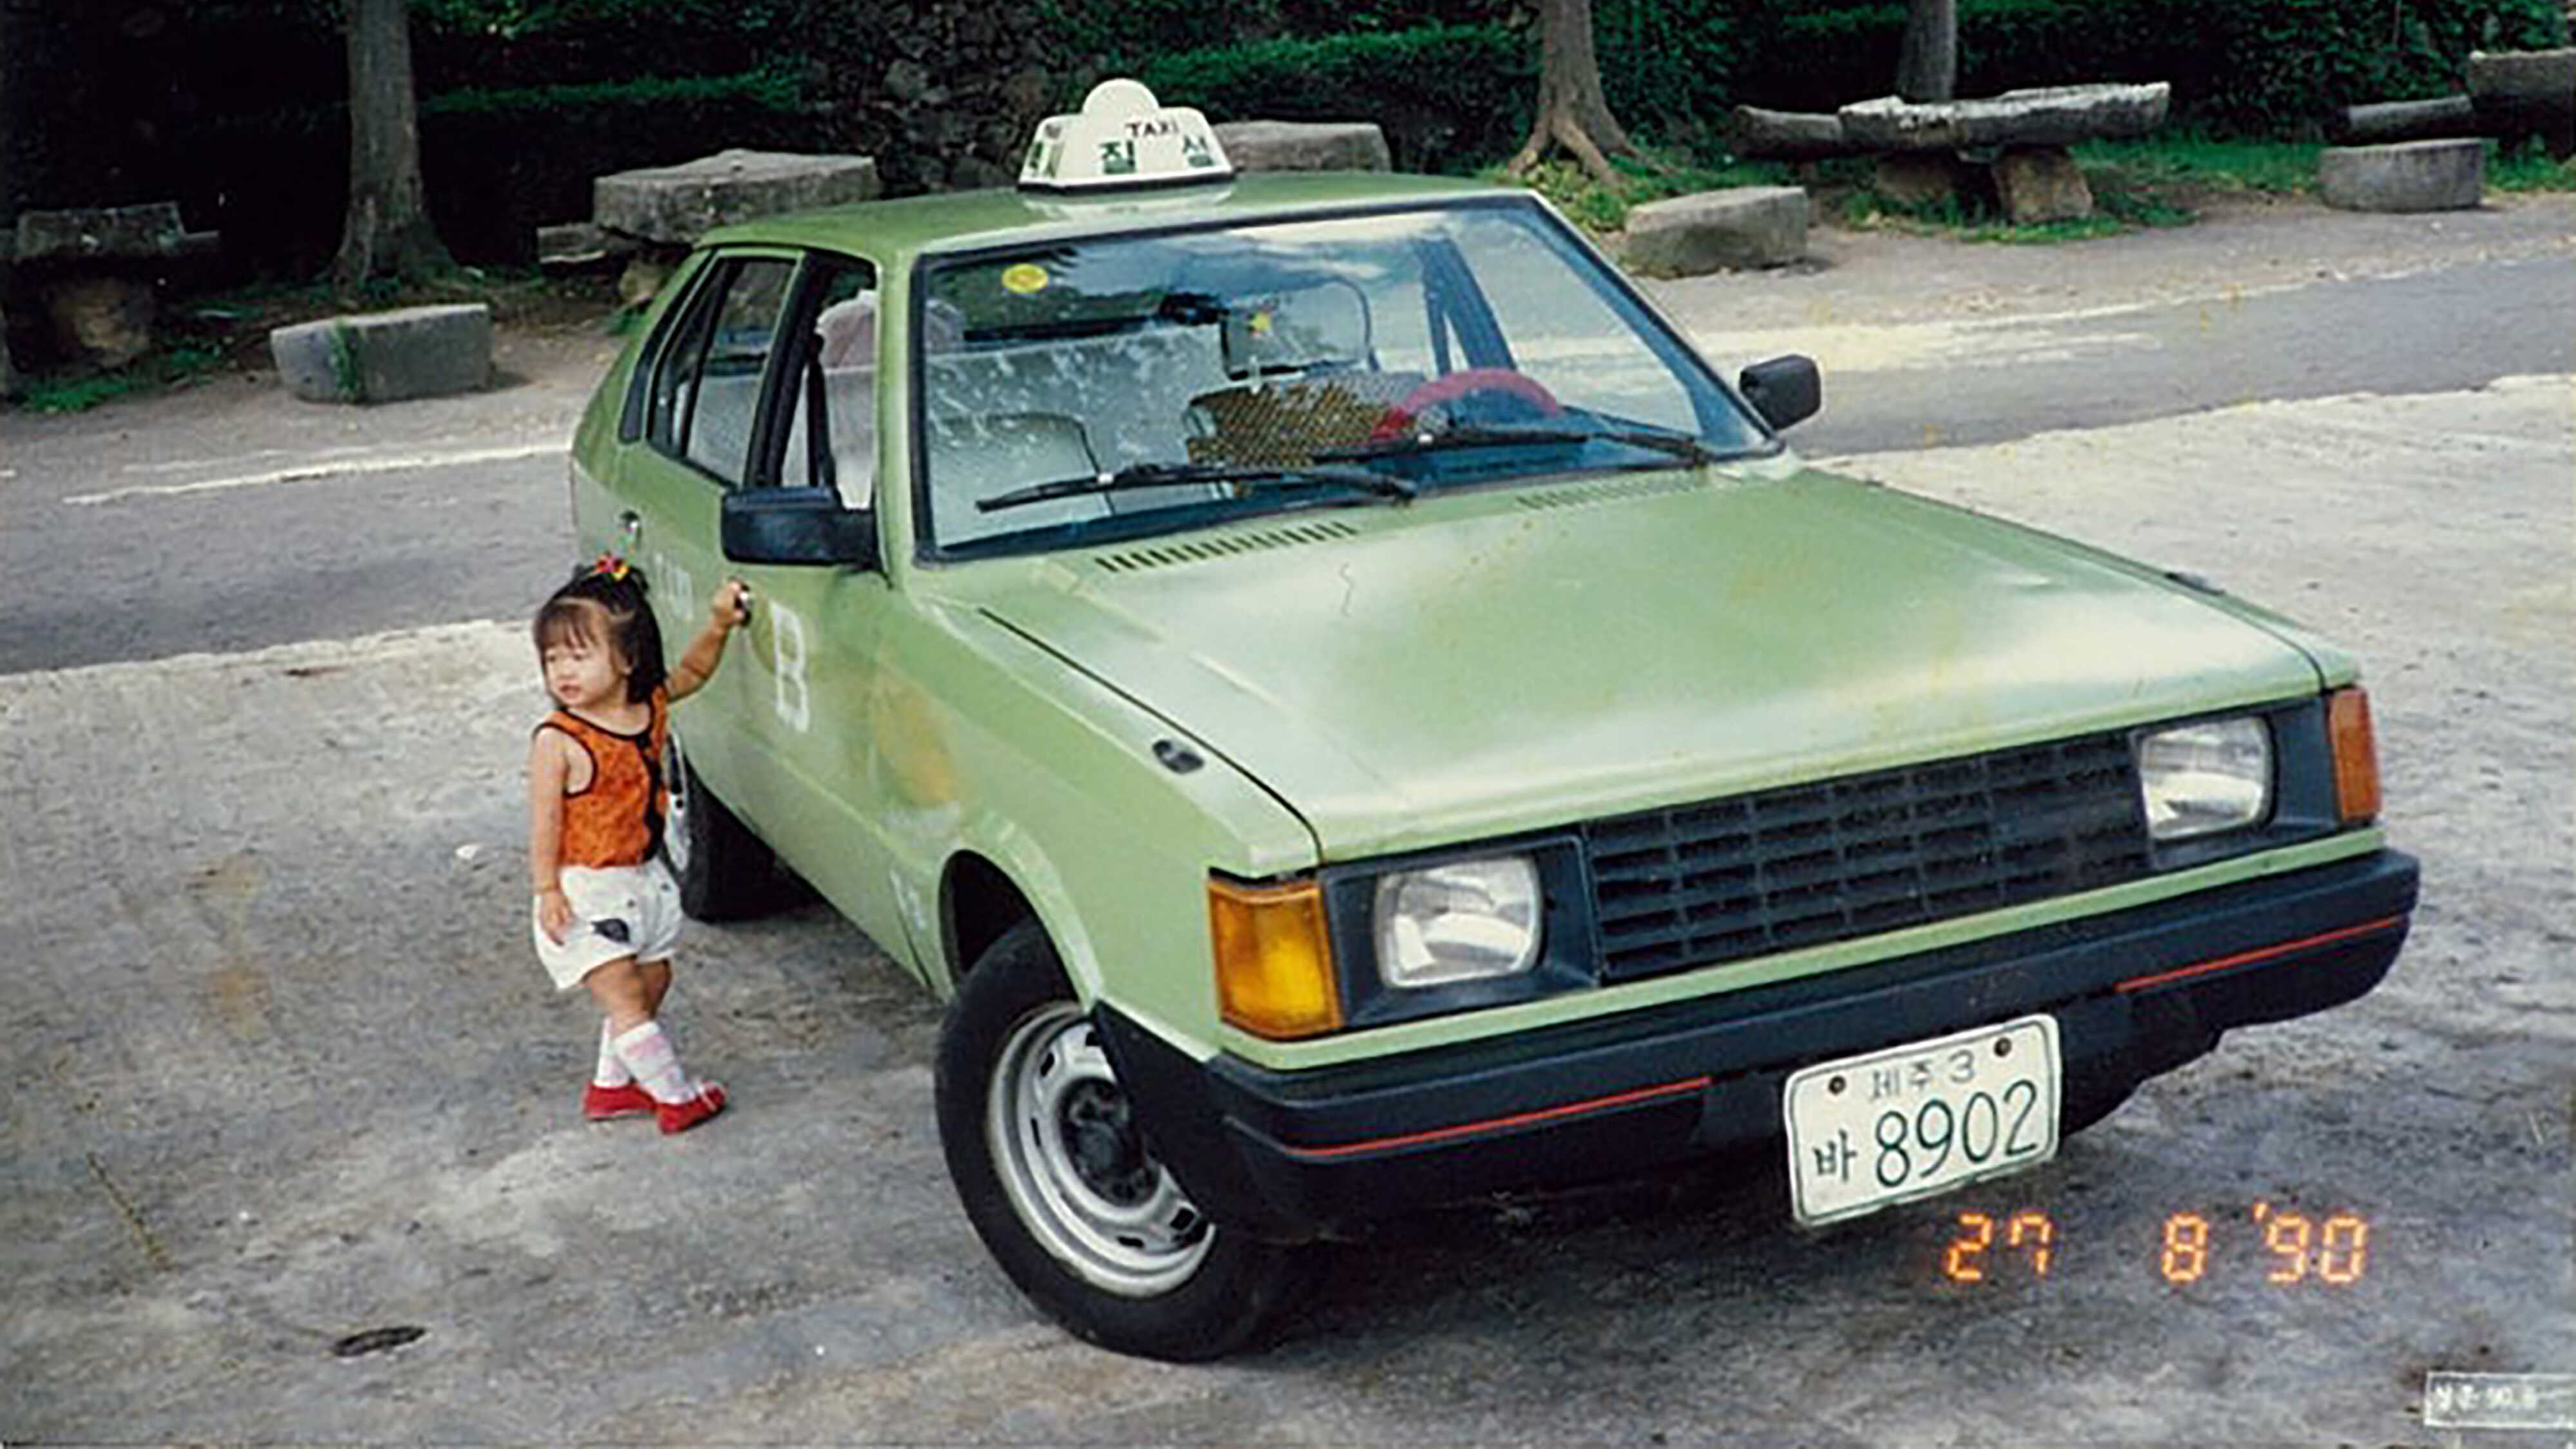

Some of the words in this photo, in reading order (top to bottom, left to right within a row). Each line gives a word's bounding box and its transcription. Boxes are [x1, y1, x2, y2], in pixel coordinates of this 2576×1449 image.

[1125, 118, 1179, 137] TAXI
[1868, 1058, 1934, 1103] 제주
[1948, 1049, 1976, 1084] 3
[1811, 1128, 1858, 1183] 바
[1875, 1079, 2038, 1187] 8902
